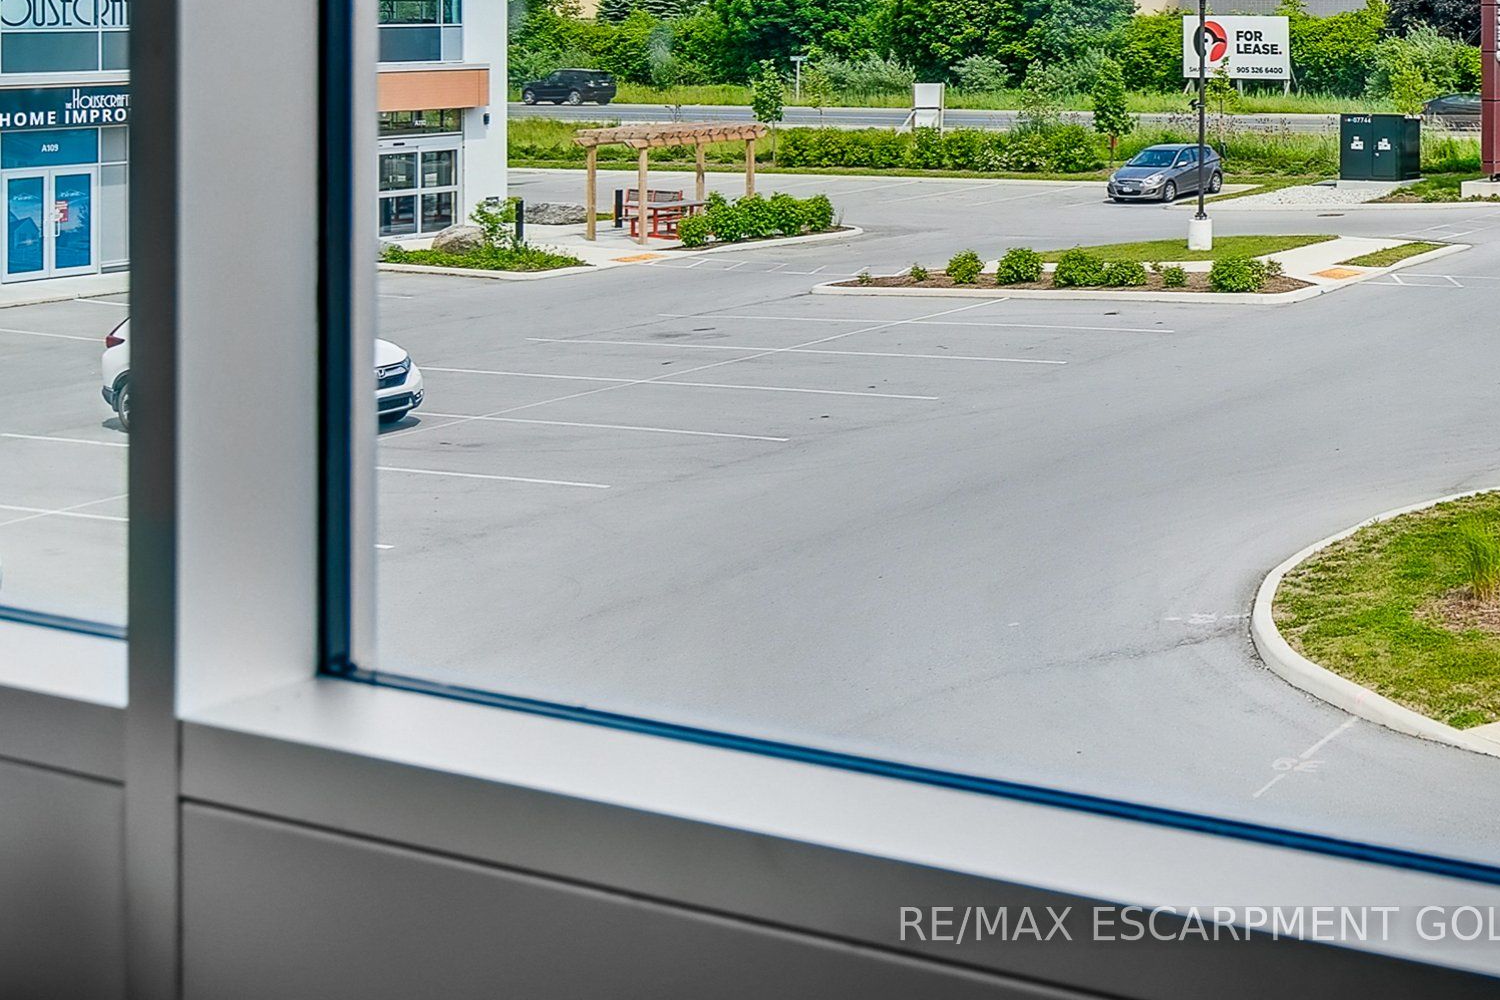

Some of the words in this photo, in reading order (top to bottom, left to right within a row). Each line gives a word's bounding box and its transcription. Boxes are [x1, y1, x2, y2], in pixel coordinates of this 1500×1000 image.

[1236, 30, 1263, 42] FOR
[1236, 44, 1282, 55] LEASE.
[0, 111, 56, 128] HOME
[41, 144, 59, 152] A109
